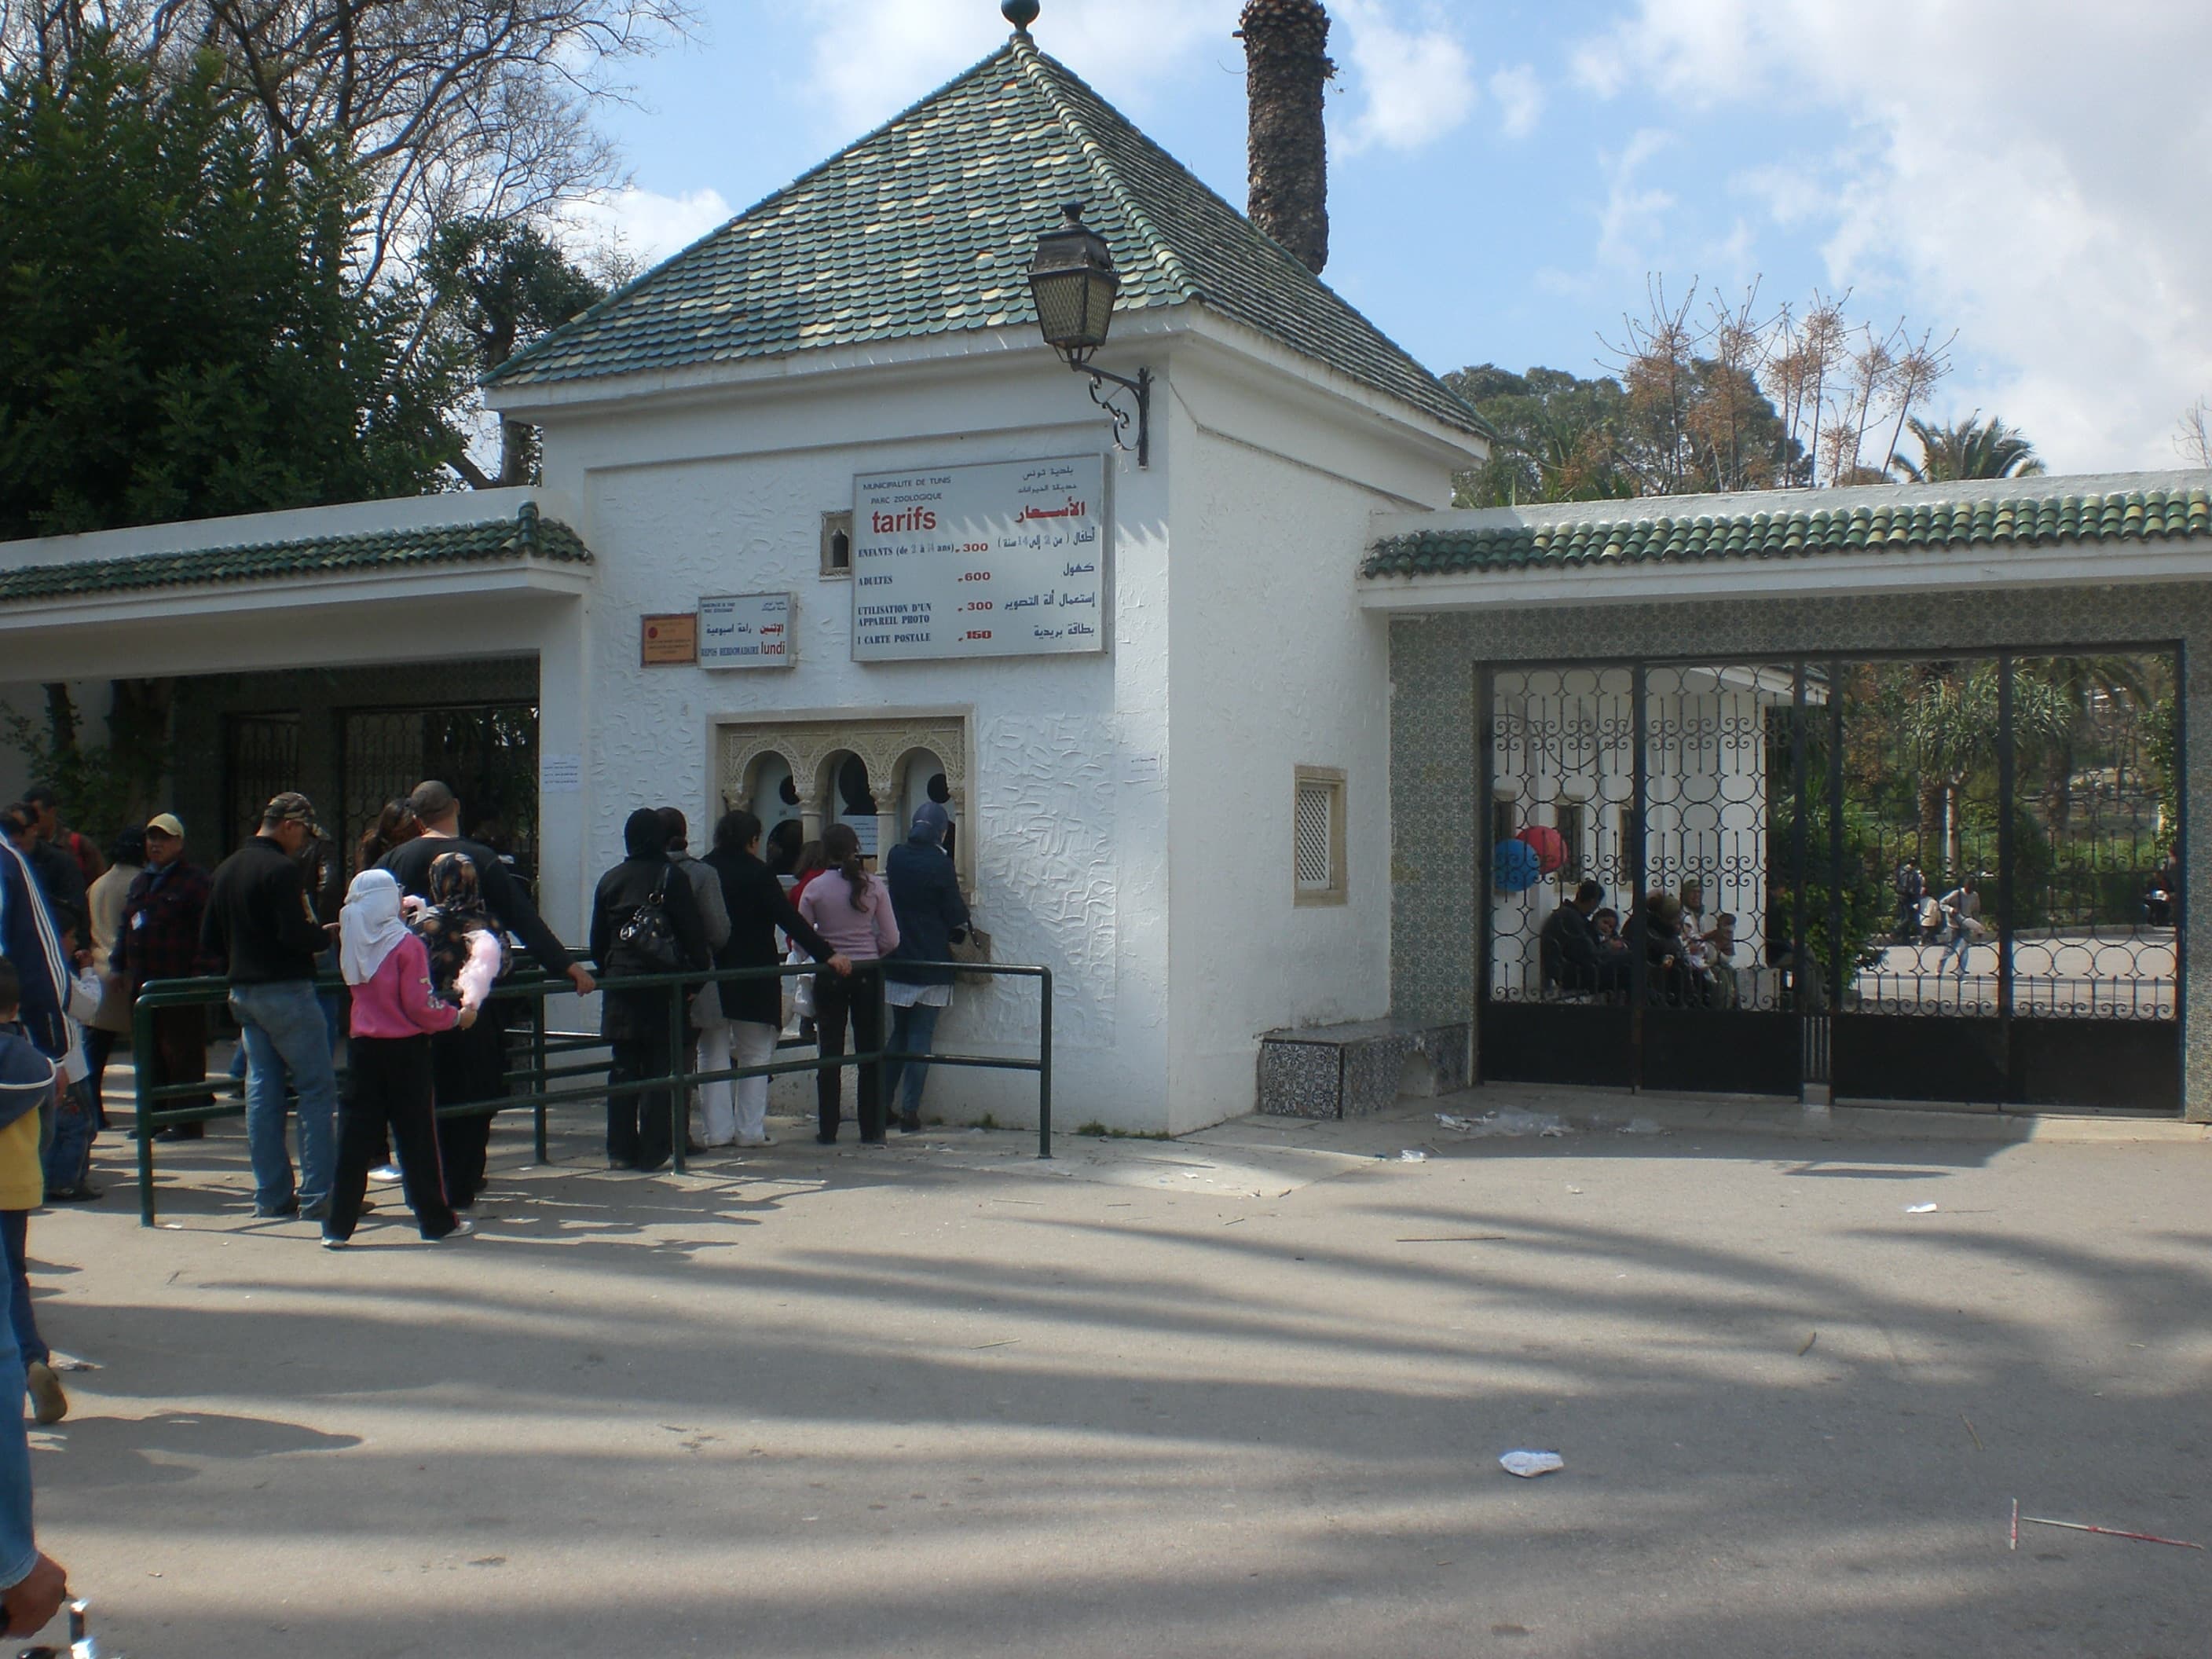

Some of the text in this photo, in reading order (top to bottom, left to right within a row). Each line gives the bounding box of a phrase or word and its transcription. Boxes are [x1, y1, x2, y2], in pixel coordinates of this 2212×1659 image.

[1023, 469, 1046, 481] تونس
[863, 476, 951, 490] MUNICIPALITE DE TUNIS
[870, 493, 943, 504] PARC ZOOLOGIQUE
[1014, 496, 1086, 524] الأسعار
[872, 506, 936, 533] tarifs
[1017, 536, 1028, 545] 14
[1029, 535, 1041, 549] إلى
[1044, 536, 1050, 545] 2
[1073, 526, 1095, 546] أطفال
[858, 547, 893, 558] ENFANTS
[896, 545, 908, 556] (de
[937, 544, 954, 553] ans)
[1063, 562, 1094, 577] كهول
[859, 575, 893, 586] ADULTES
[1005, 595, 1039, 610] التصوير
[1059, 592, 1096, 608] إستعمال
[858, 604, 909, 616] UTILISATION
[912, 602, 932, 613] D'UN
[859, 614, 930, 627] APPAREIL PHOTO
[1034, 622, 1095, 639] بطاقة بريدية
[864, 634, 891, 645] CARTE
[894, 632, 931, 643] POSTALE
[760, 641, 786, 654] lundi
